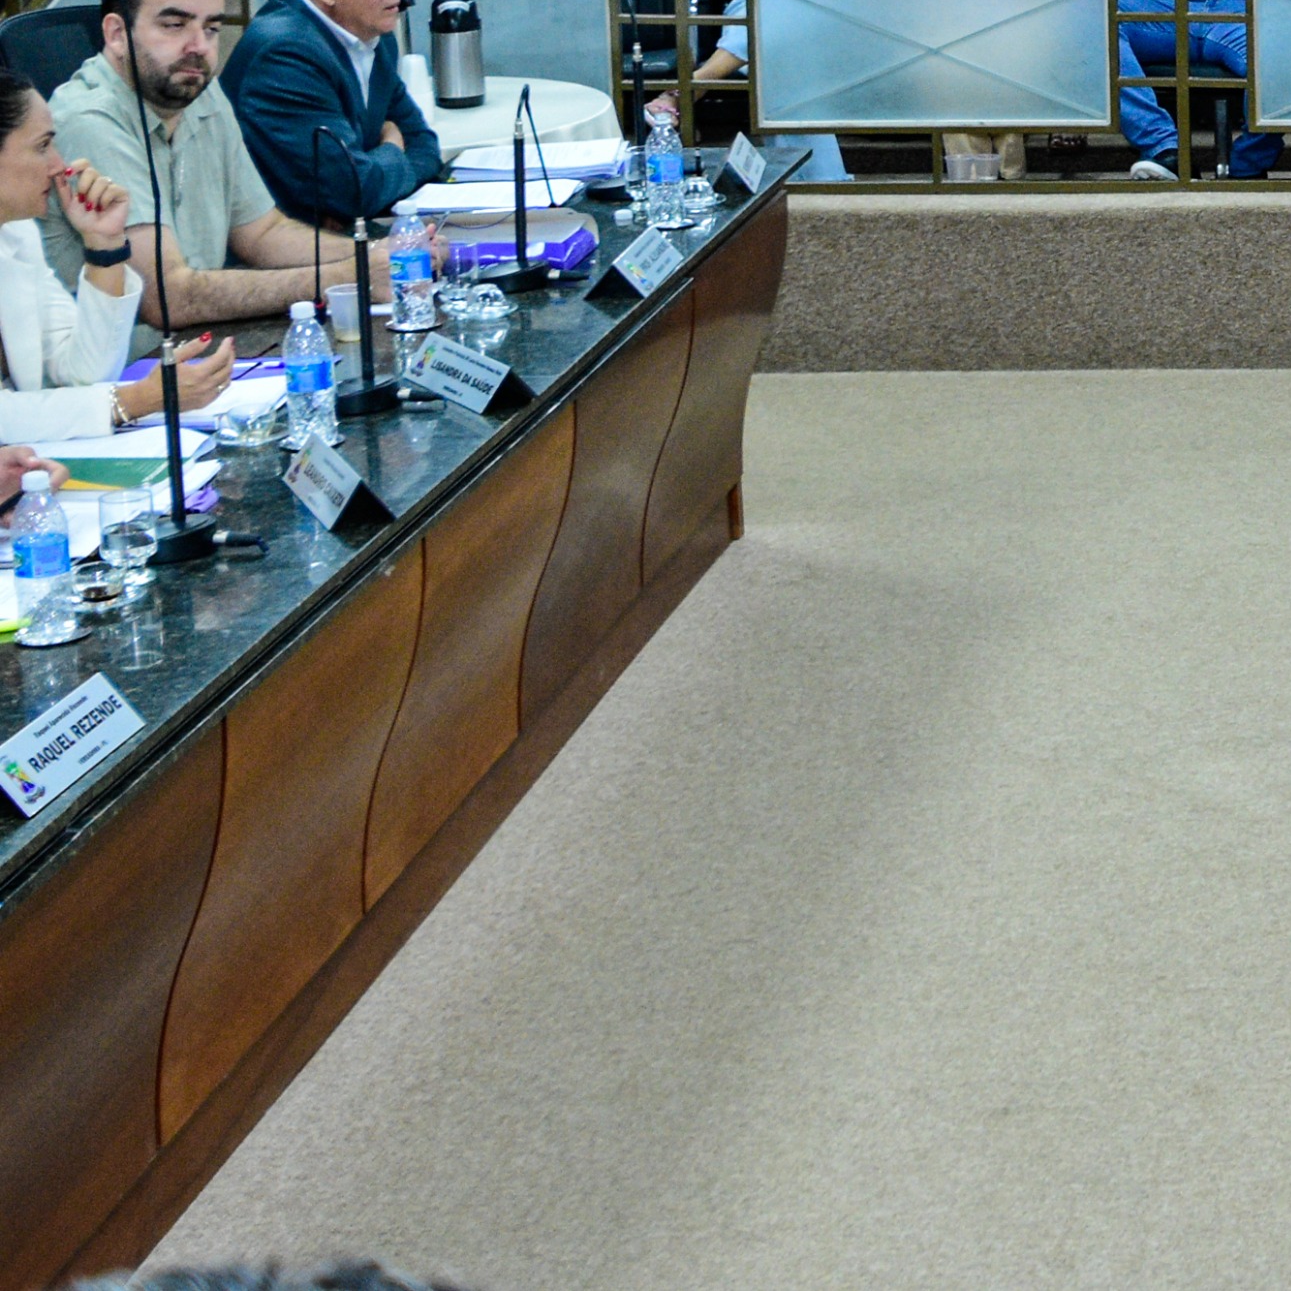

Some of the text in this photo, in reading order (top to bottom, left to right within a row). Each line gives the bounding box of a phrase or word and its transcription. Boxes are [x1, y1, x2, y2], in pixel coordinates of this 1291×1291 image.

[430, 359, 463, 380] LISANDRA
[460, 372, 473, 386] DA
[470, 375, 495, 396] SAÚDE
[28, 694, 122, 773] RAQUEL REZENDE
